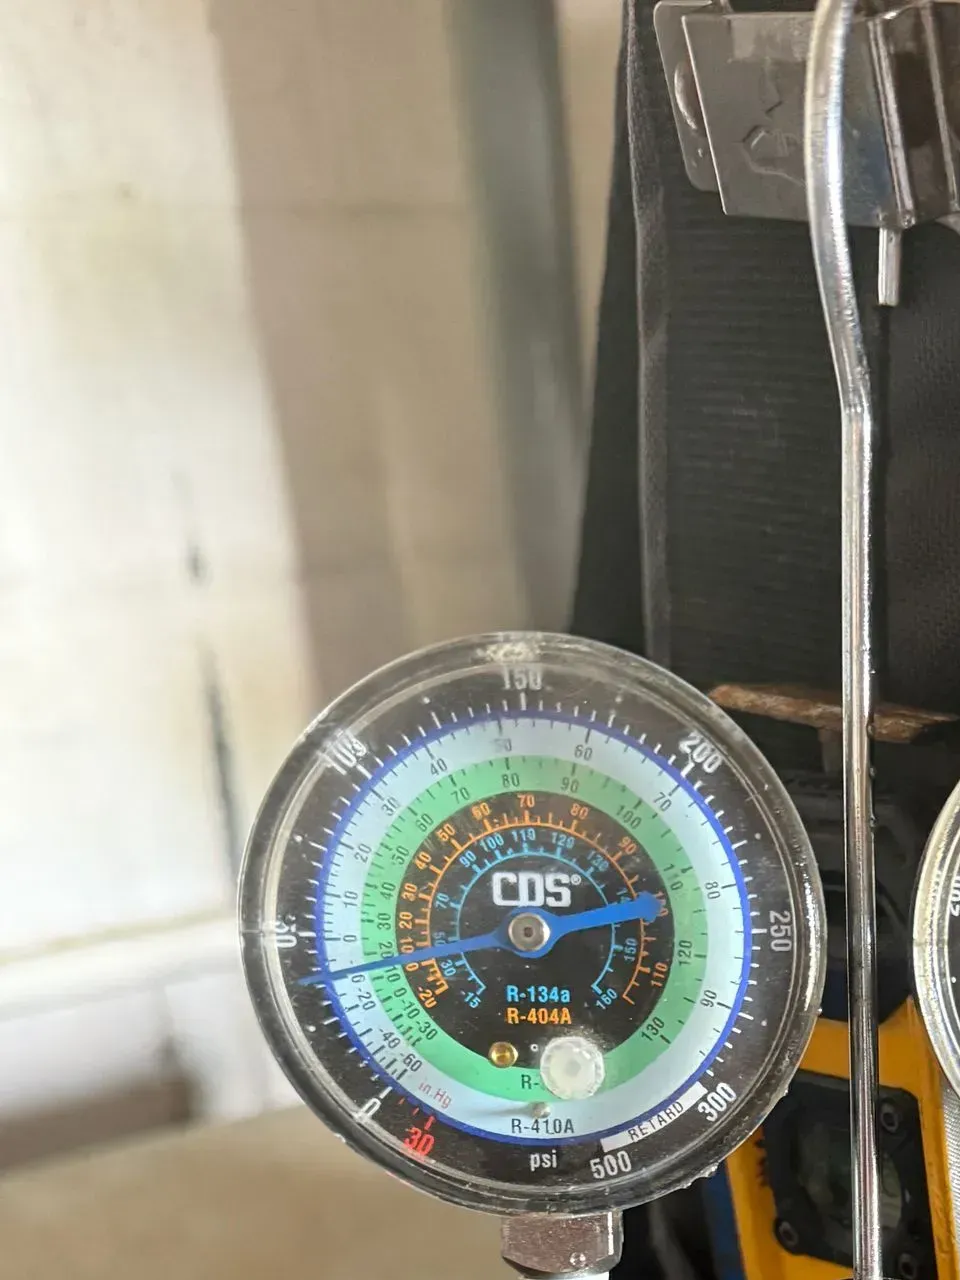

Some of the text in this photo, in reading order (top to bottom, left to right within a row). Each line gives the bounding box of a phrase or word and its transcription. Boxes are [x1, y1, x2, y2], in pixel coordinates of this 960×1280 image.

[502, 665, 543, 690] 150
[574, 744, 593, 761] 60
[679, 731, 723, 773] 200
[430, 758, 448, 776] 40
[502, 772, 520, 788] 80
[560, 776, 580, 794] 90
[451, 786, 471, 804] 70
[517, 794, 536, 808] 70
[654, 792, 672, 812] 70
[381, 797, 399, 817] 30
[471, 802, 492, 821] 60
[570, 803, 590, 820] 80
[415, 813, 434, 833] 60
[615, 805, 642, 830] 100
[436, 823, 456, 842] 50
[512, 828, 536, 842] 110
[551, 832, 575, 849] 120
[480, 833, 505, 852] 100
[618, 836, 638, 855] 90
[354, 843, 372, 863] 20
[413, 851, 432, 870] 40
[459, 850, 476, 868] 90
[663, 863, 684, 891] 110
[344, 890, 358, 908] 10
[380, 882, 396, 900] 40
[402, 882, 417, 902] 30
[704, 881, 721, 900] 80
[435, 893, 450, 910] 70
[377, 913, 391, 931] 30
[399, 912, 413, 930] 20
[769, 911, 792, 952] 250
[400, 936, 415, 954] 10
[624, 938, 638, 962] 150
[678, 940, 693, 966] 120
[441, 959, 456, 977] 30
[651, 961, 669, 988] 110
[357, 988, 376, 1011] -20
[417, 986, 437, 1009] -20
[506, 985, 571, 1003] R-134a
[596, 988, 618, 1010] 160
[700, 989, 717, 1008] 90
[400, 999, 421, 1020] -10
[507, 1007, 573, 1025] R-404A
[378, 1027, 401, 1049] -40
[415, 1021, 438, 1041] -30
[641, 1016, 665, 1041] 130
[399, 1053, 423, 1072] -60
[697, 1082, 737, 1122] 300
[511, 1118, 575, 1135] R-410A
[628, 1101, 685, 1141] RETARD
[404, 1127, 435, 1157] 30
[530, 1149, 557, 1172] psi
[590, 1150, 632, 1180] 500
